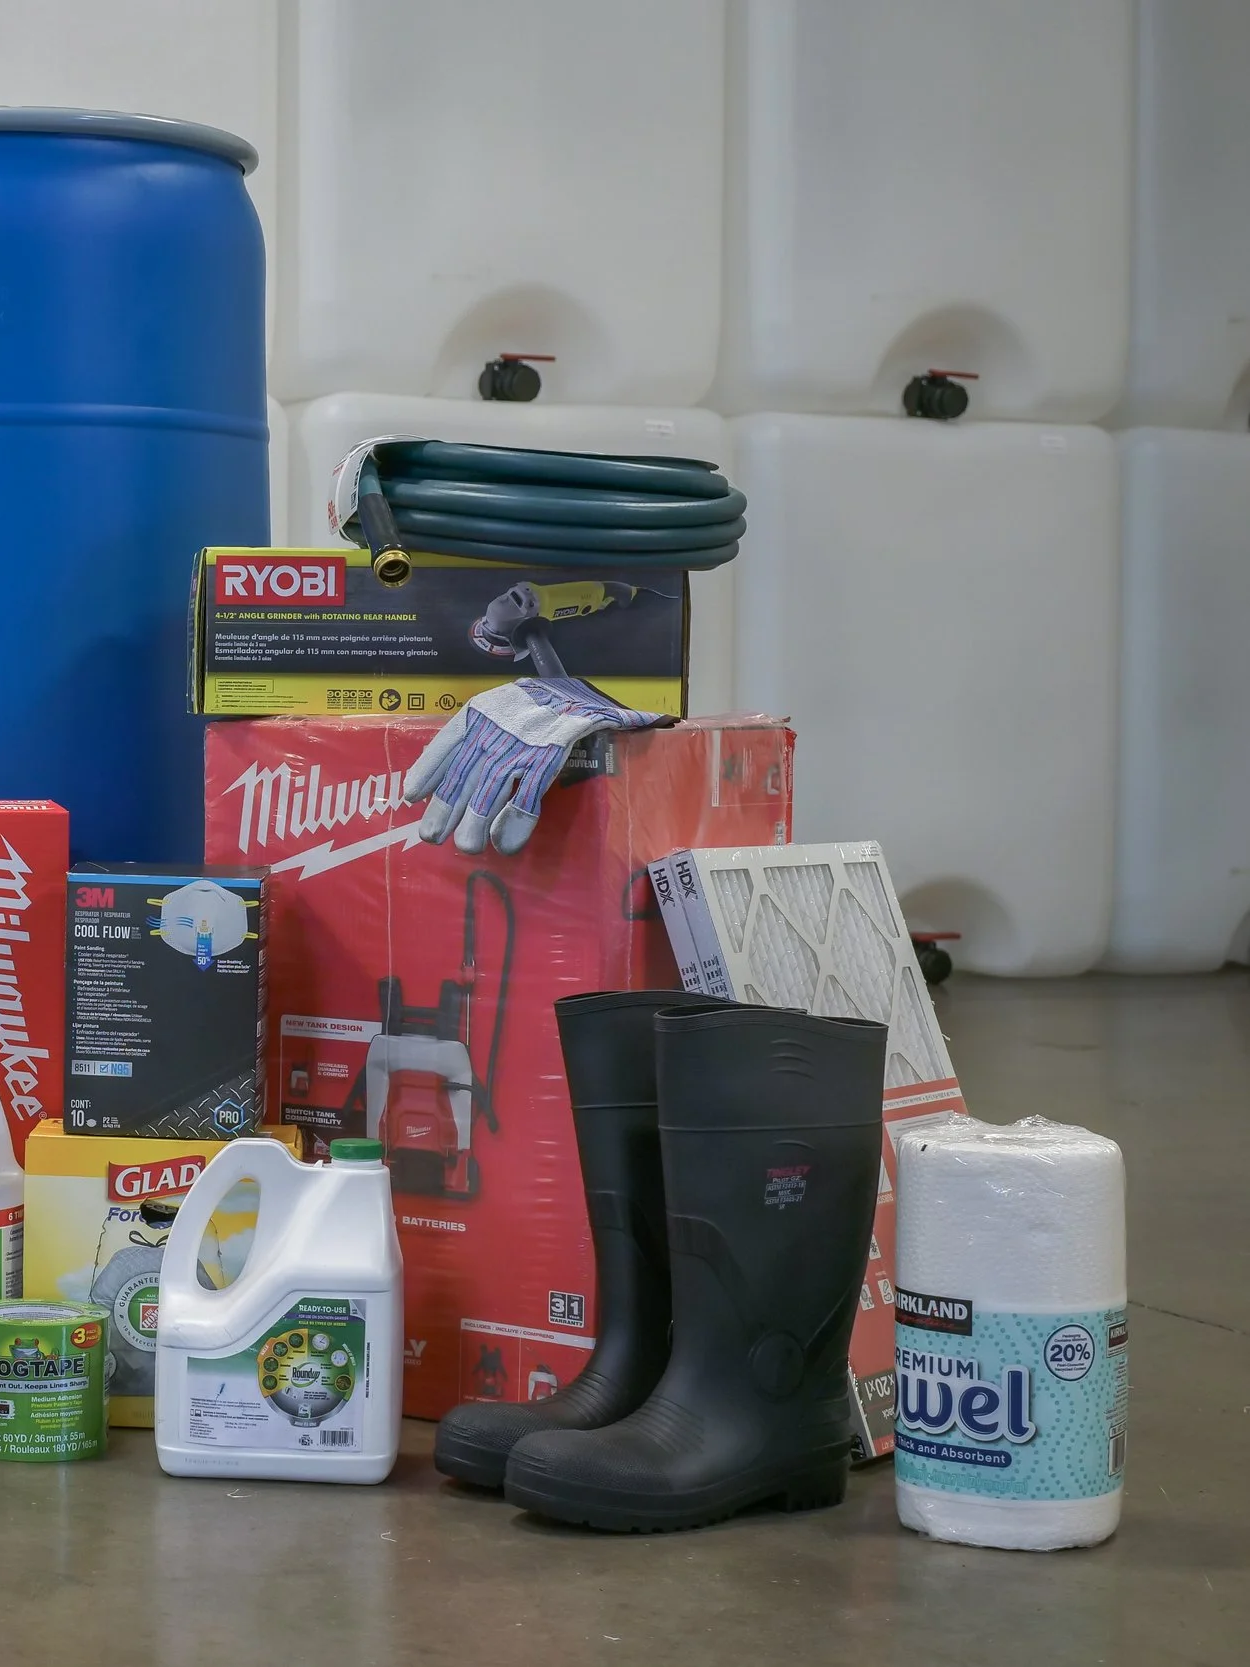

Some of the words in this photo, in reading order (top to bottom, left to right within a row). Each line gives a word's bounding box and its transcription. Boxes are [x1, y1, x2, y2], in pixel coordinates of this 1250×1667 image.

[222, 565, 336, 597] RYOBI
[239, 612, 265, 620] ANGLE
[267, 612, 302, 621] GRINDER
[304, 612, 320, 620] with
[322, 613, 361, 621] ROTATING
[363, 613, 383, 621] REAR
[384, 613, 417, 621] HANDLE
[554, 606, 578, 618] RYOBI
[215, 633, 249, 641] Meuleuse
[251, 633, 279, 643] d'angle
[340, 634, 370, 644] poignée
[398, 635, 433, 644] pivotante
[215, 647, 263, 655] Esmeriladora
[265, 647, 294, 656] angular
[295, 647, 305, 655] de
[351, 650, 377, 658] mango
[406, 649, 438, 658] giratorio
[221, 760, 416, 854] Milwau
[653, 867, 674, 906] HDX
[676, 860, 697, 899] HDX
[75, 886, 114, 909] 3M
[74, 924, 100, 938] COOL
[102, 925, 131, 939] FLOW
[285, 1019, 304, 1027] NEW
[306, 1021, 328, 1029] TANK
[330, 1023, 362, 1032] DESIGN
[74, 1063, 90, 1072] 8511
[110, 1063, 129, 1075] N95
[70, 1099, 92, 1109] CONT:
[70, 1109, 85, 1127] 10
[219, 1110, 239, 1124] PRO
[285, 1107, 314, 1116] SWITCH
[316, 1110, 336, 1118] TANK
[285, 1114, 342, 1126] COMPATIBILITY
[114, 1163, 202, 1197] GLAD
[402, 1215, 467, 1232] BATTERIES
[298, 1305, 347, 1314] READY-TO-USE
[551, 1297, 565, 1313] 3
[570, 1301, 578, 1315] 1
[549, 1316, 584, 1326] WARRANTY
[72, 1327, 86, 1344] 3
[1049, 1342, 1091, 1363] 20%
[895, 1349, 975, 1381] REMIUM
[292, 1367, 321, 1380] Roundup
[896, 1370, 1031, 1438] wel
[9, 1444, 50, 1454] Rouleaux
[917, 1442, 937, 1455] and
[941, 1446, 1006, 1464] Absorbent
